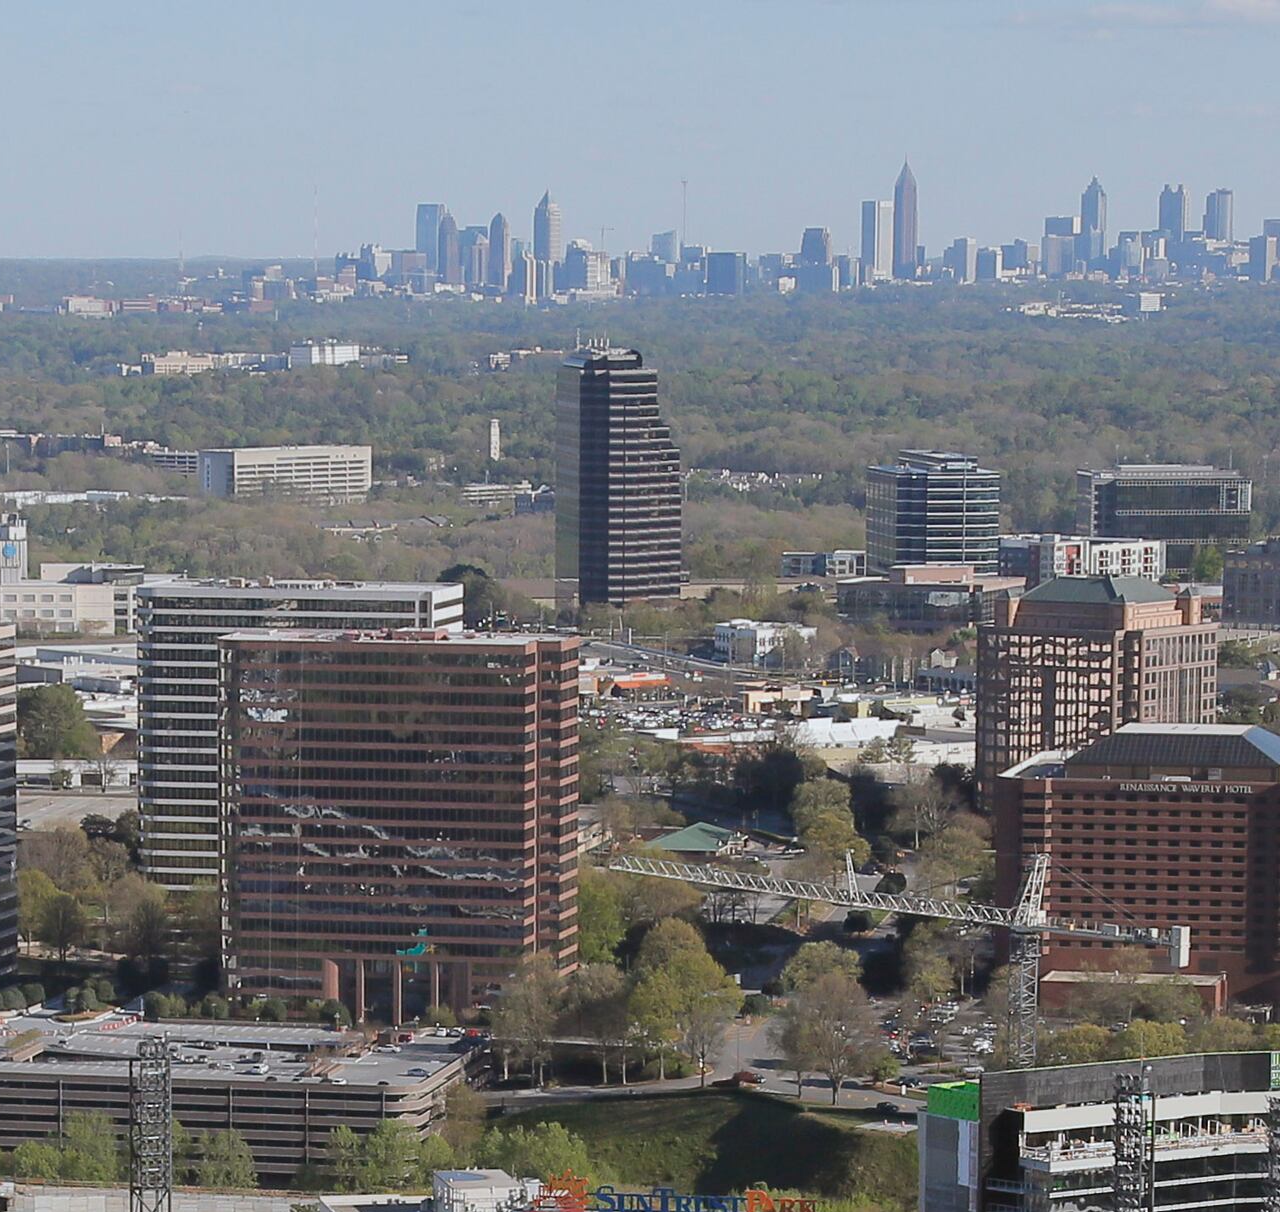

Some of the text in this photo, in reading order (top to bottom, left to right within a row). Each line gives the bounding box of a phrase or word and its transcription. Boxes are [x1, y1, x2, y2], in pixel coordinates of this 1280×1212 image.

[1120, 783, 1253, 793] RENAISSANCE WAVERLY HOTEL
